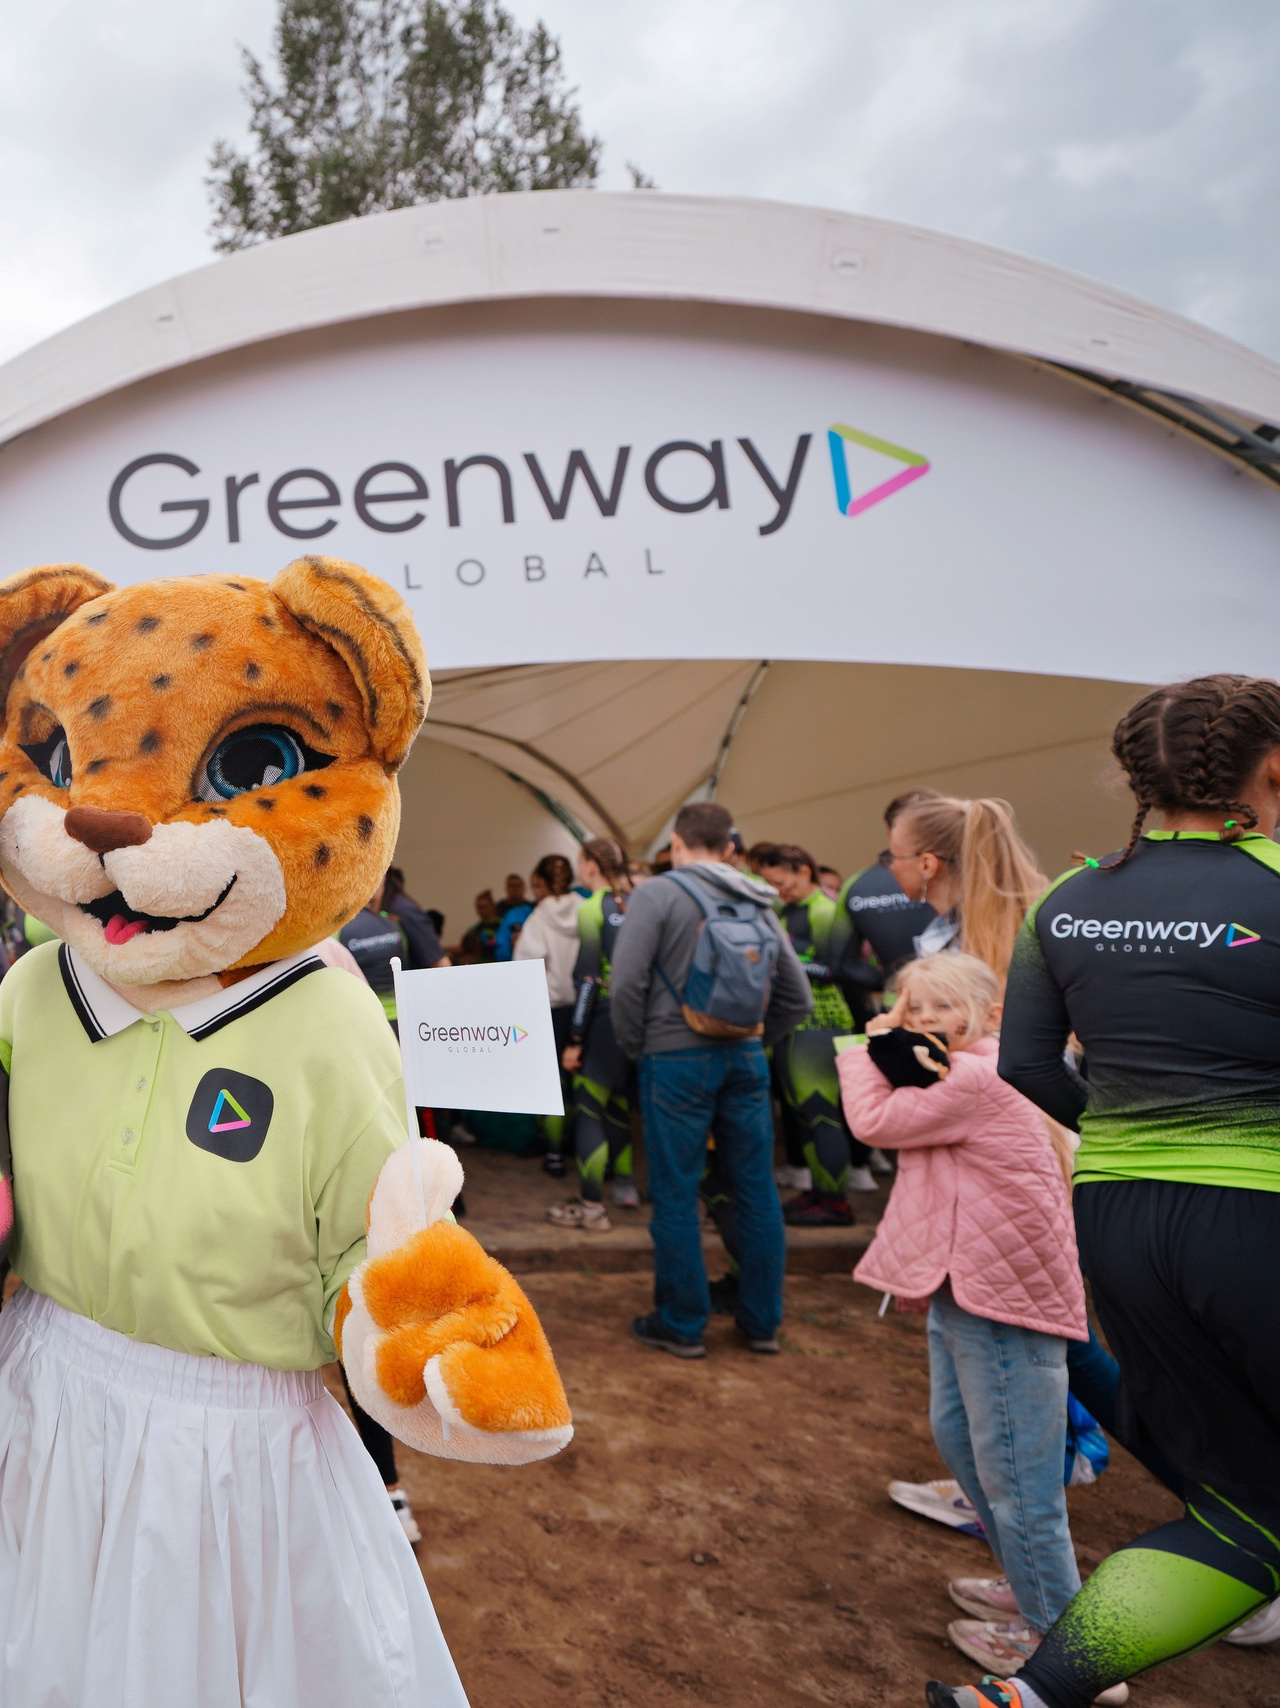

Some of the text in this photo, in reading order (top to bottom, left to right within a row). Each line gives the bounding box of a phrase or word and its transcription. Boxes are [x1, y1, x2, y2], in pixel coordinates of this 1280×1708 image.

[108, 433, 813, 551] Greenway
[404, 548, 666, 590] LOBAL
[848, 893, 911, 912] Green
[1050, 913, 1226, 948] Greenway
[1094, 943, 1176, 954] GLOBAL
[418, 1022, 511, 1047] Greenway
